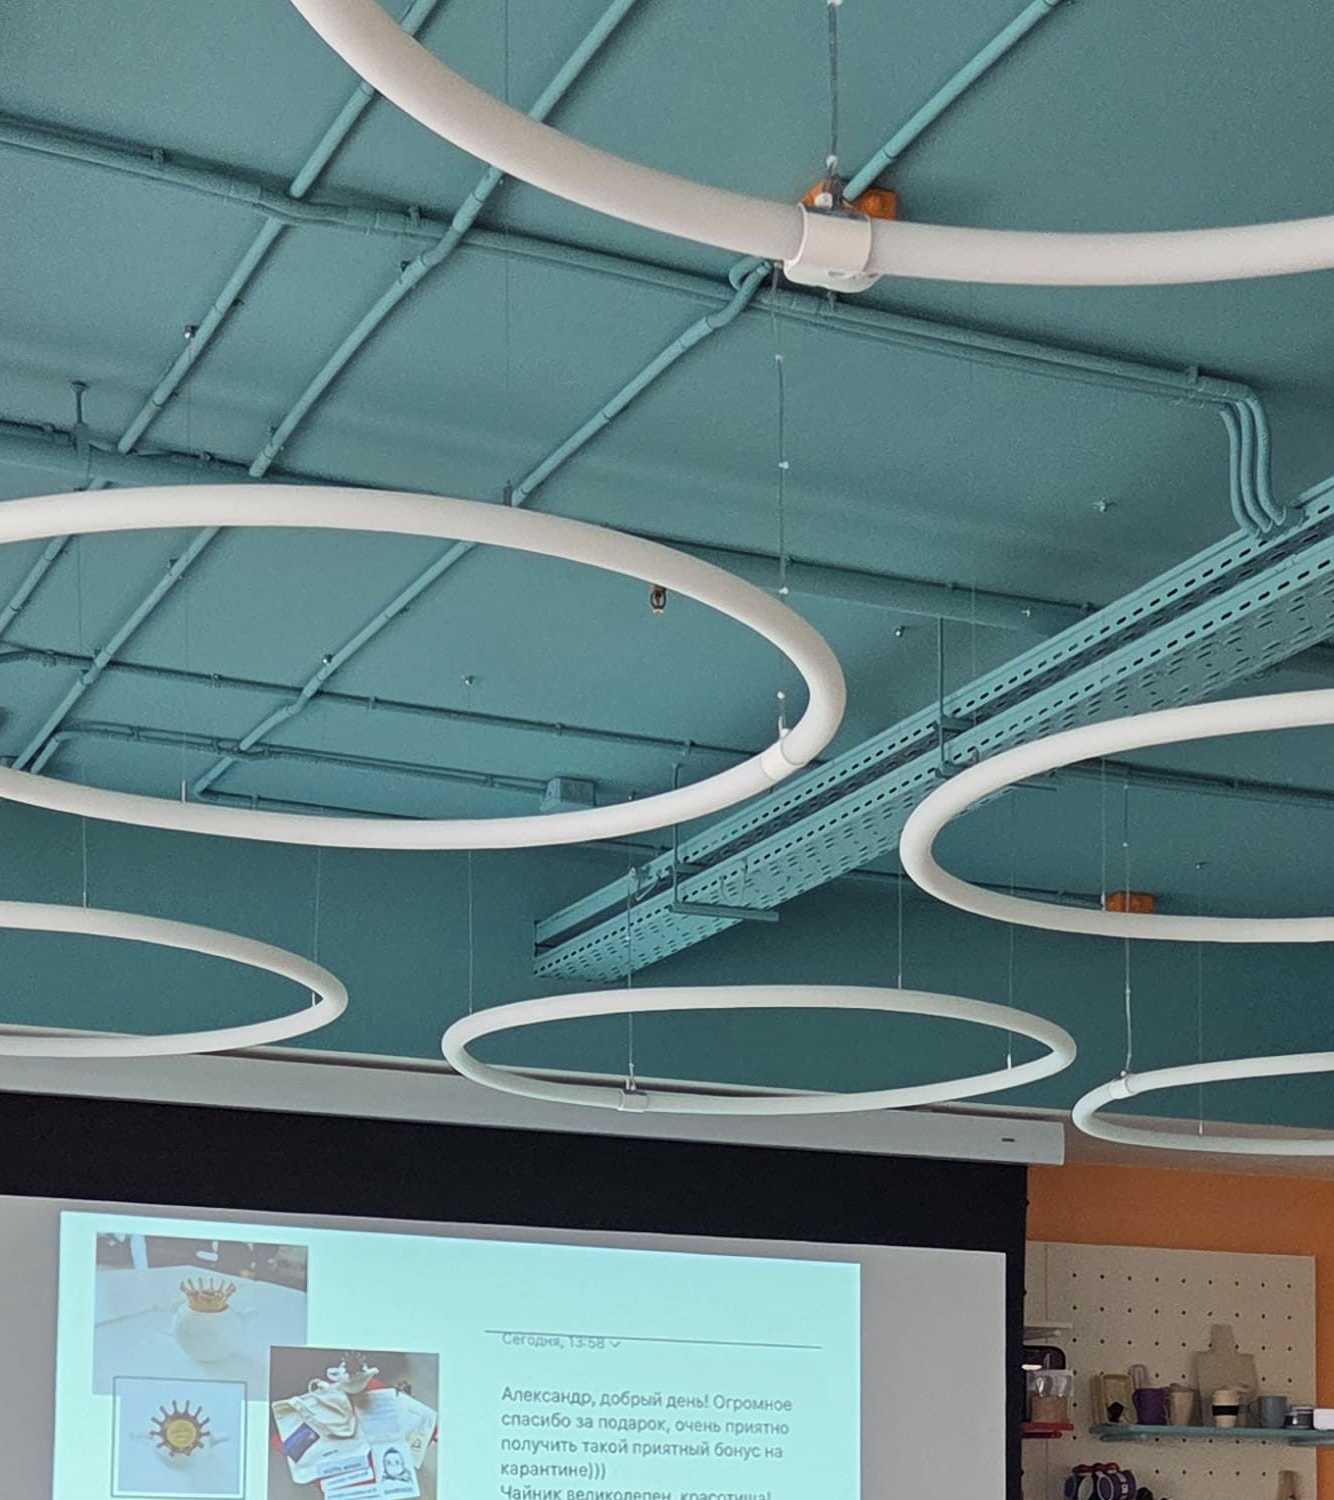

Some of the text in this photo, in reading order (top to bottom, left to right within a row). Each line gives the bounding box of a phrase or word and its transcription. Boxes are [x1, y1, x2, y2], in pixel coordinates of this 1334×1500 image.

[501, 1386, 793, 1412] Александр, добрый день! Огромное
[501, 1412, 789, 1436] спасибо за подарок, очень приятно
[501, 1438, 784, 1460] получить такой приятный бонус на
[501, 1462, 606, 1480] карантине)))
[500, 1484, 562, 1500] Чайник
